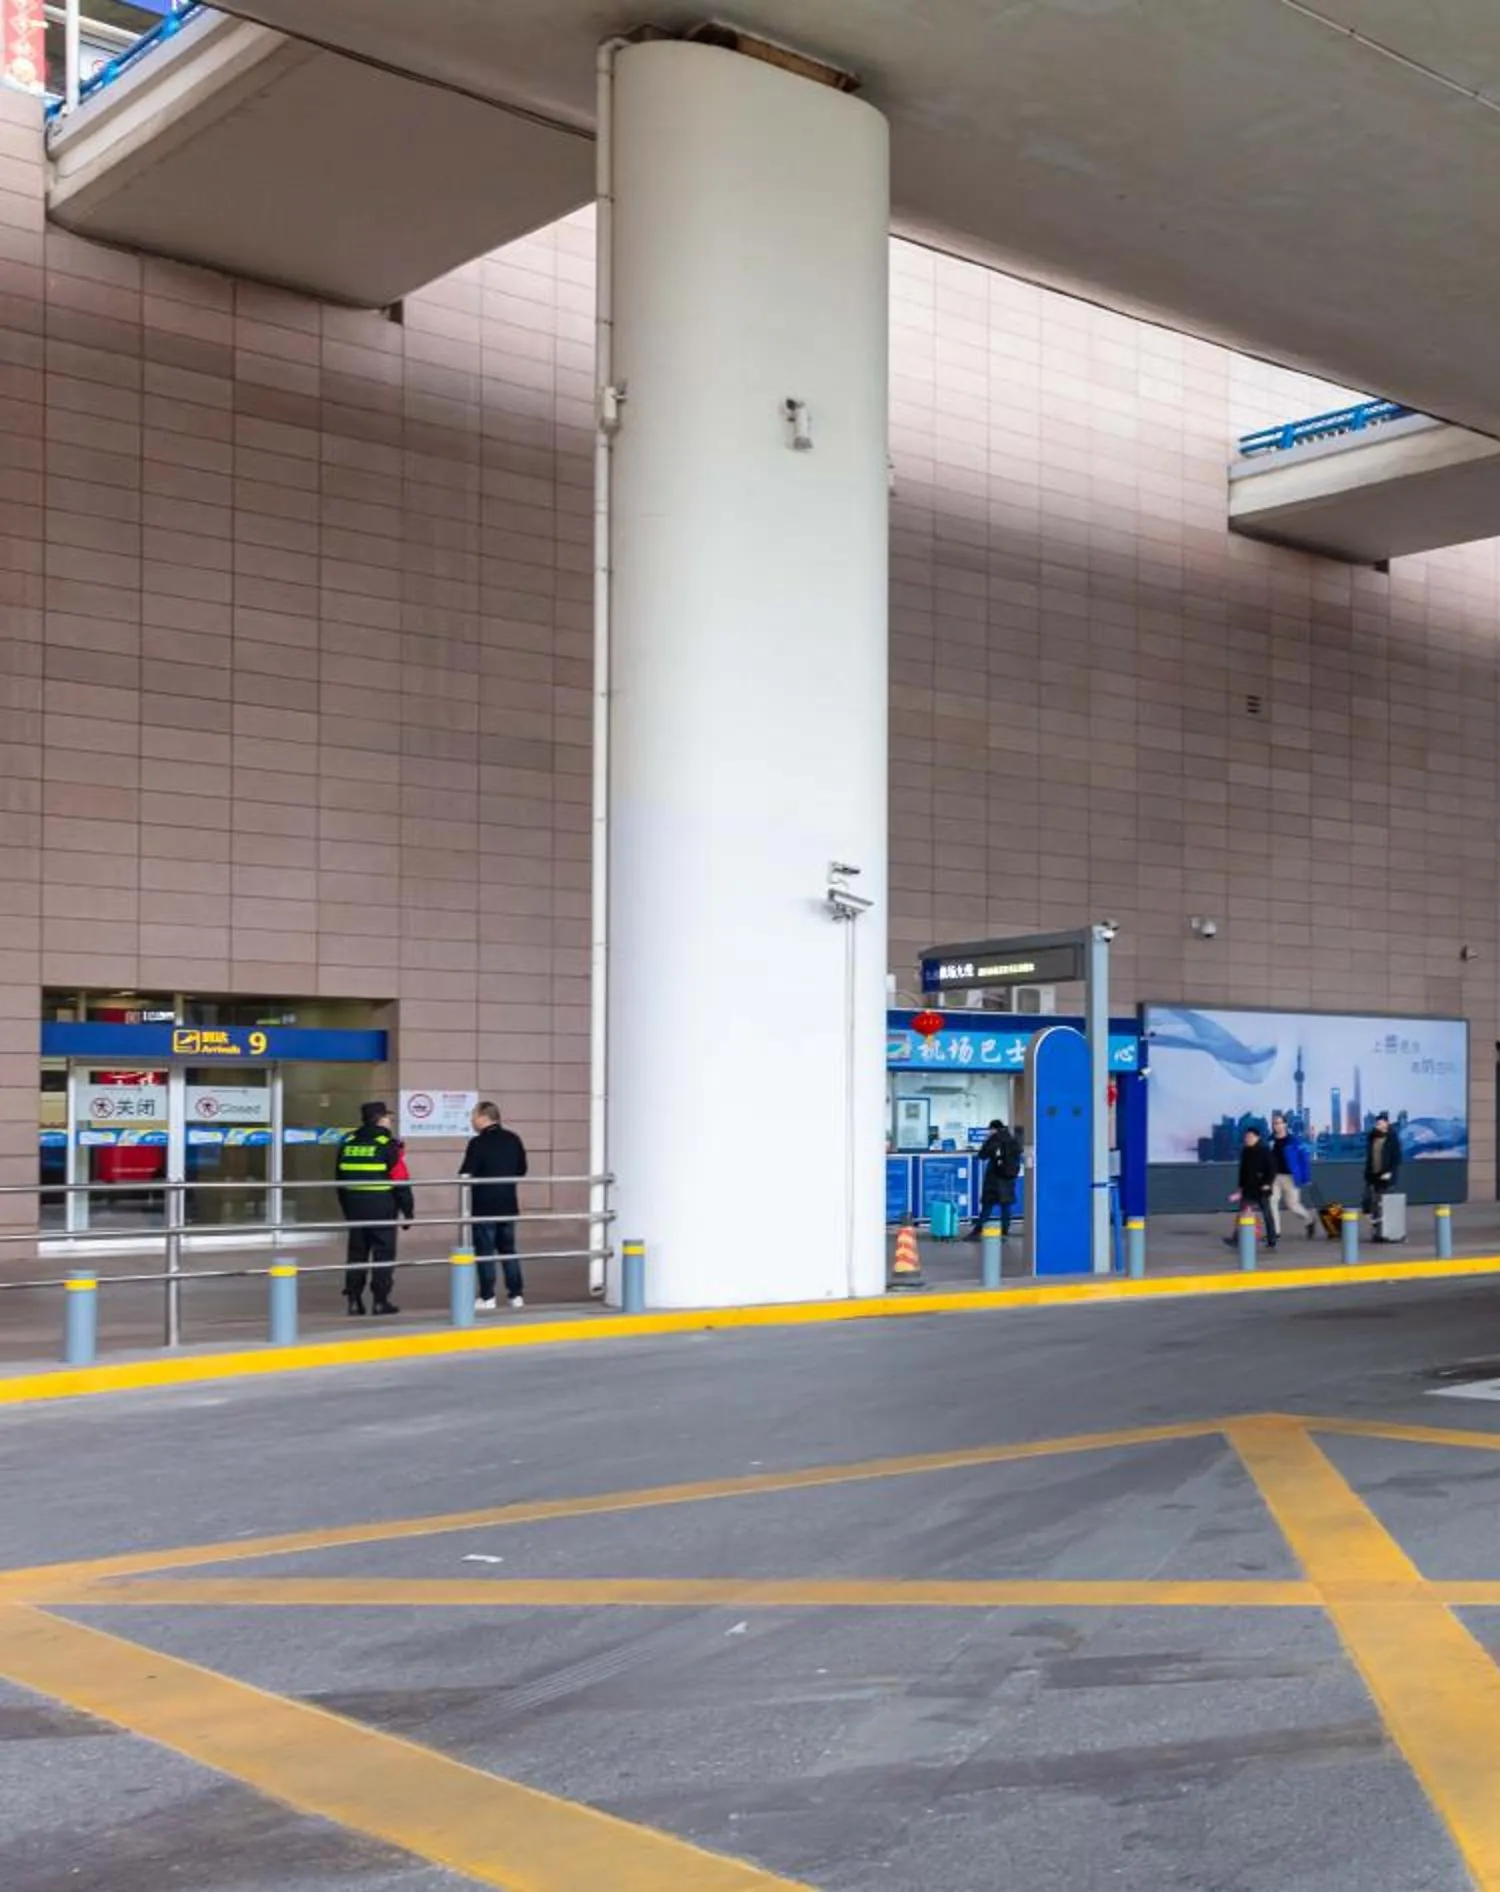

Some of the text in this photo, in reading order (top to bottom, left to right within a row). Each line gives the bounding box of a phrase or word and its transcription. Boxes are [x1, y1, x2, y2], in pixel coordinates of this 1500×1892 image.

[249, 1031, 268, 1055] 9
[116, 1099, 155, 1116] 关闭
[219, 1103, 261, 1115] Closed
